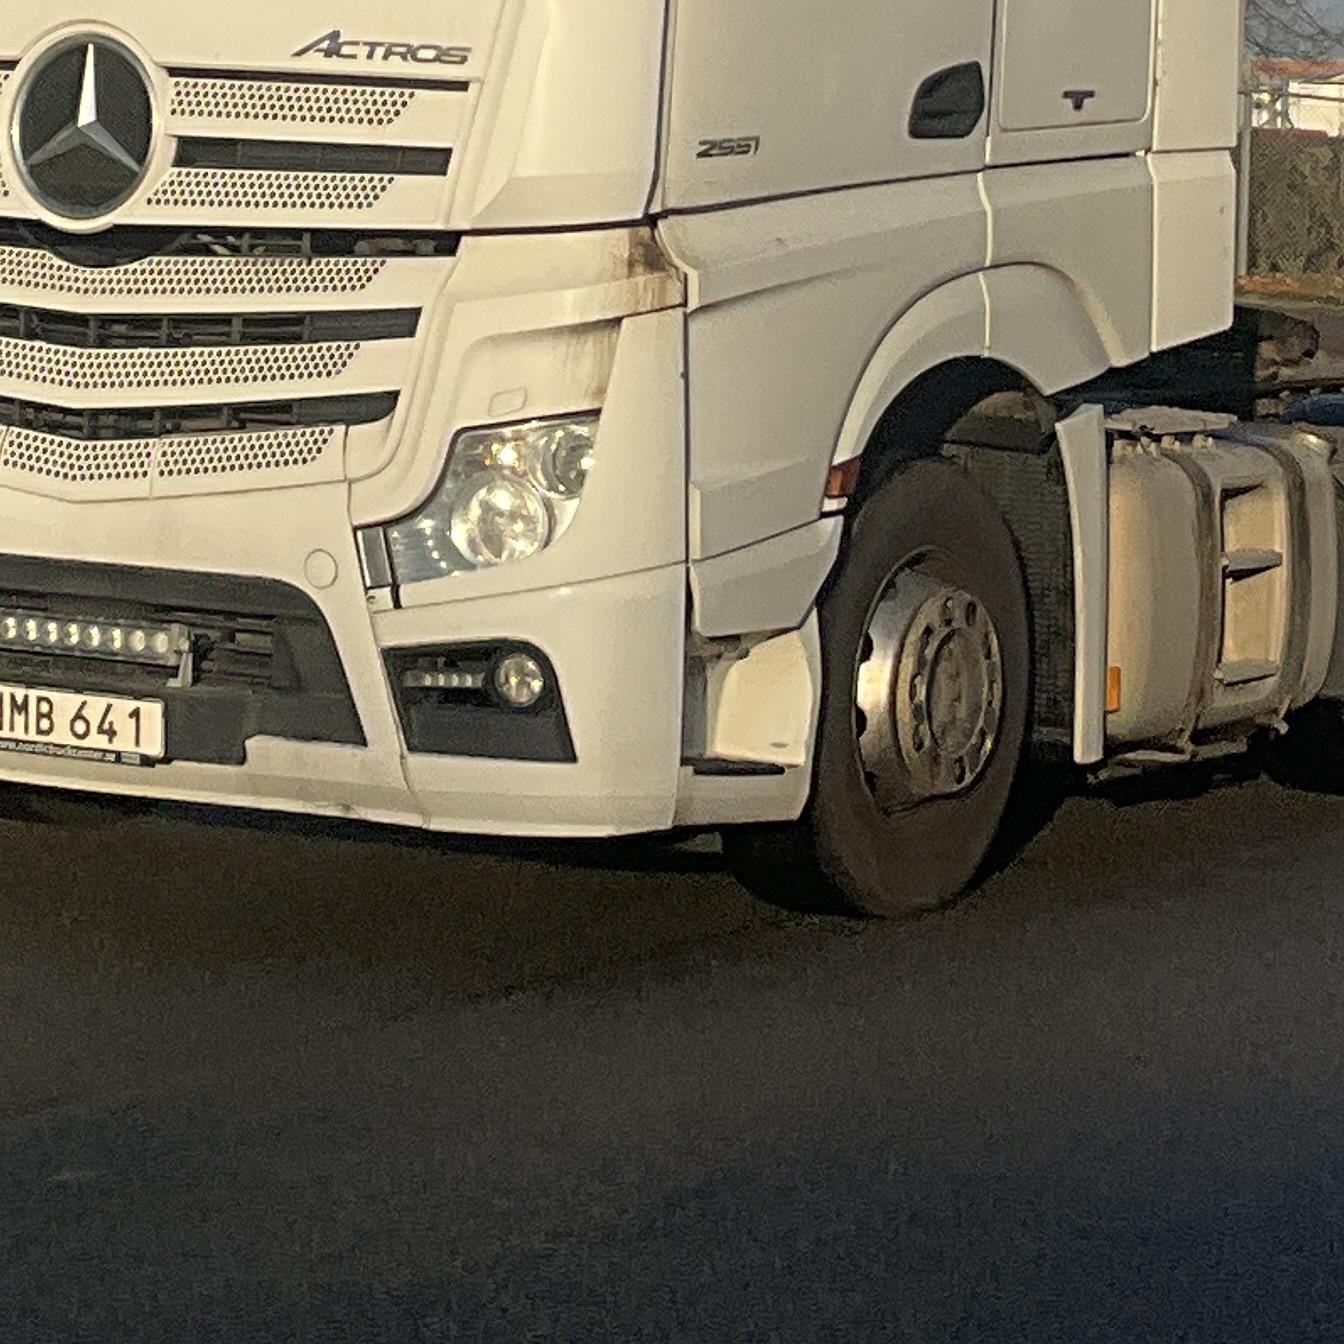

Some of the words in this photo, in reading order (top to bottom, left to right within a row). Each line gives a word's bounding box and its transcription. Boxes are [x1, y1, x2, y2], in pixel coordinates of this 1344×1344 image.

[290, 30, 472, 65] ACTROS
[696, 136, 760, 158] 2551
[69, 699, 142, 748] 641
